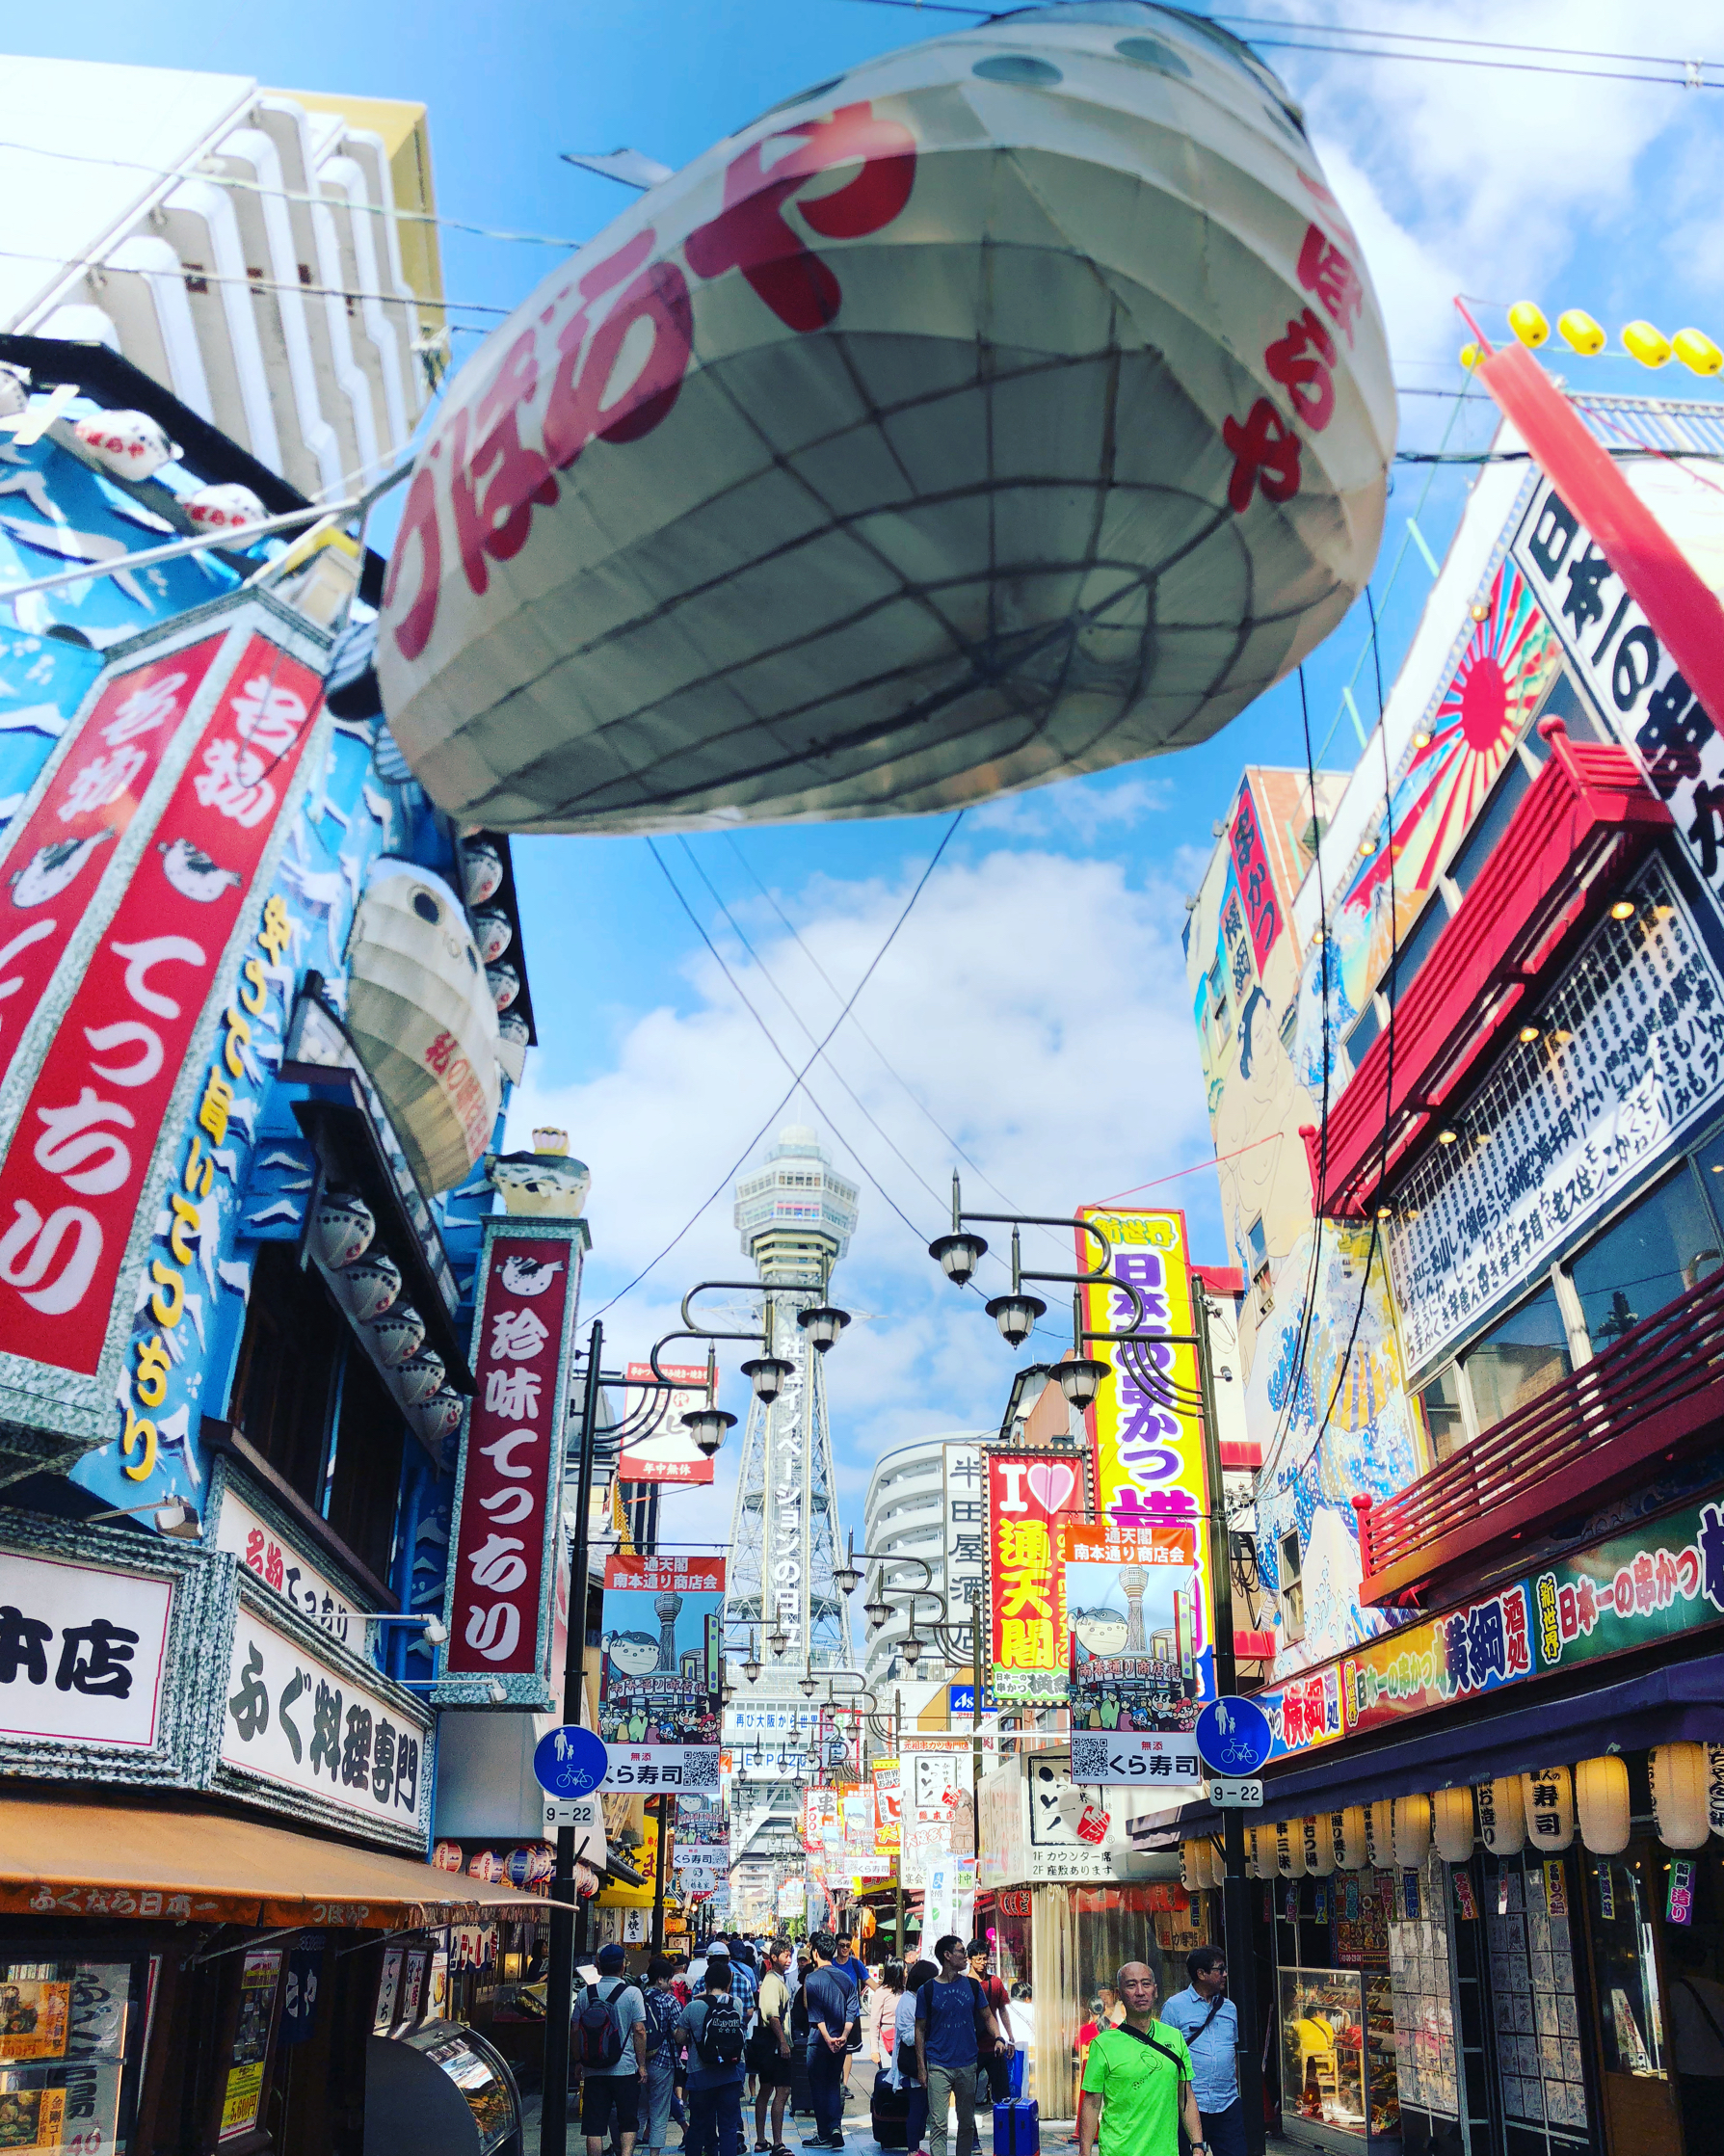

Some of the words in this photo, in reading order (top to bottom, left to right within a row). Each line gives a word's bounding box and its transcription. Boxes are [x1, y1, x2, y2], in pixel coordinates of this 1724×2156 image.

[642, 1462, 692, 1476] 年中無休
[1104, 1528, 1153, 1544] 通天閣
[1074, 1545, 1185, 1563] 南本通り商店会
[643, 1557, 689, 1573] 通天閣
[613, 1573, 719, 1590] 南本通り商店会
[998, 1518, 1055, 1669] 通天閣
[1558, 1549, 1699, 1639] 日本一の串かつ
[1539, 1576, 1560, 1660] 新世界
[1357, 1653, 1434, 1710] 日本一の串かつ
[1434, 1600, 1506, 1697] 横綱
[1502, 1591, 1530, 1674] 酒処
[1078, 1661, 1181, 1680] 南本通り商店街
[996, 1683, 1027, 1693] 串かつ
[1283, 1677, 1326, 1747] 横綱
[1324, 1670, 1339, 1733] 酒処
[229, 1639, 418, 1814] ふぐ料理専門
[1141, 1741, 1164, 1752] 無添
[630, 1752, 651, 1762] 無添
[1108, 1755, 1199, 1777] くら寿司
[1532, 1784, 1561, 1837] 寿司
[1303, 1824, 1318, 1868] もつ鍋
[1033, 1851, 1044, 1861] 1F
[1047, 1850, 1113, 1862] カウンター席
[1033, 1865, 1044, 1875] 2F
[1047, 1865, 1113, 1877] 座敷あります
[30, 1885, 220, 1918] ふぐなら日本一
